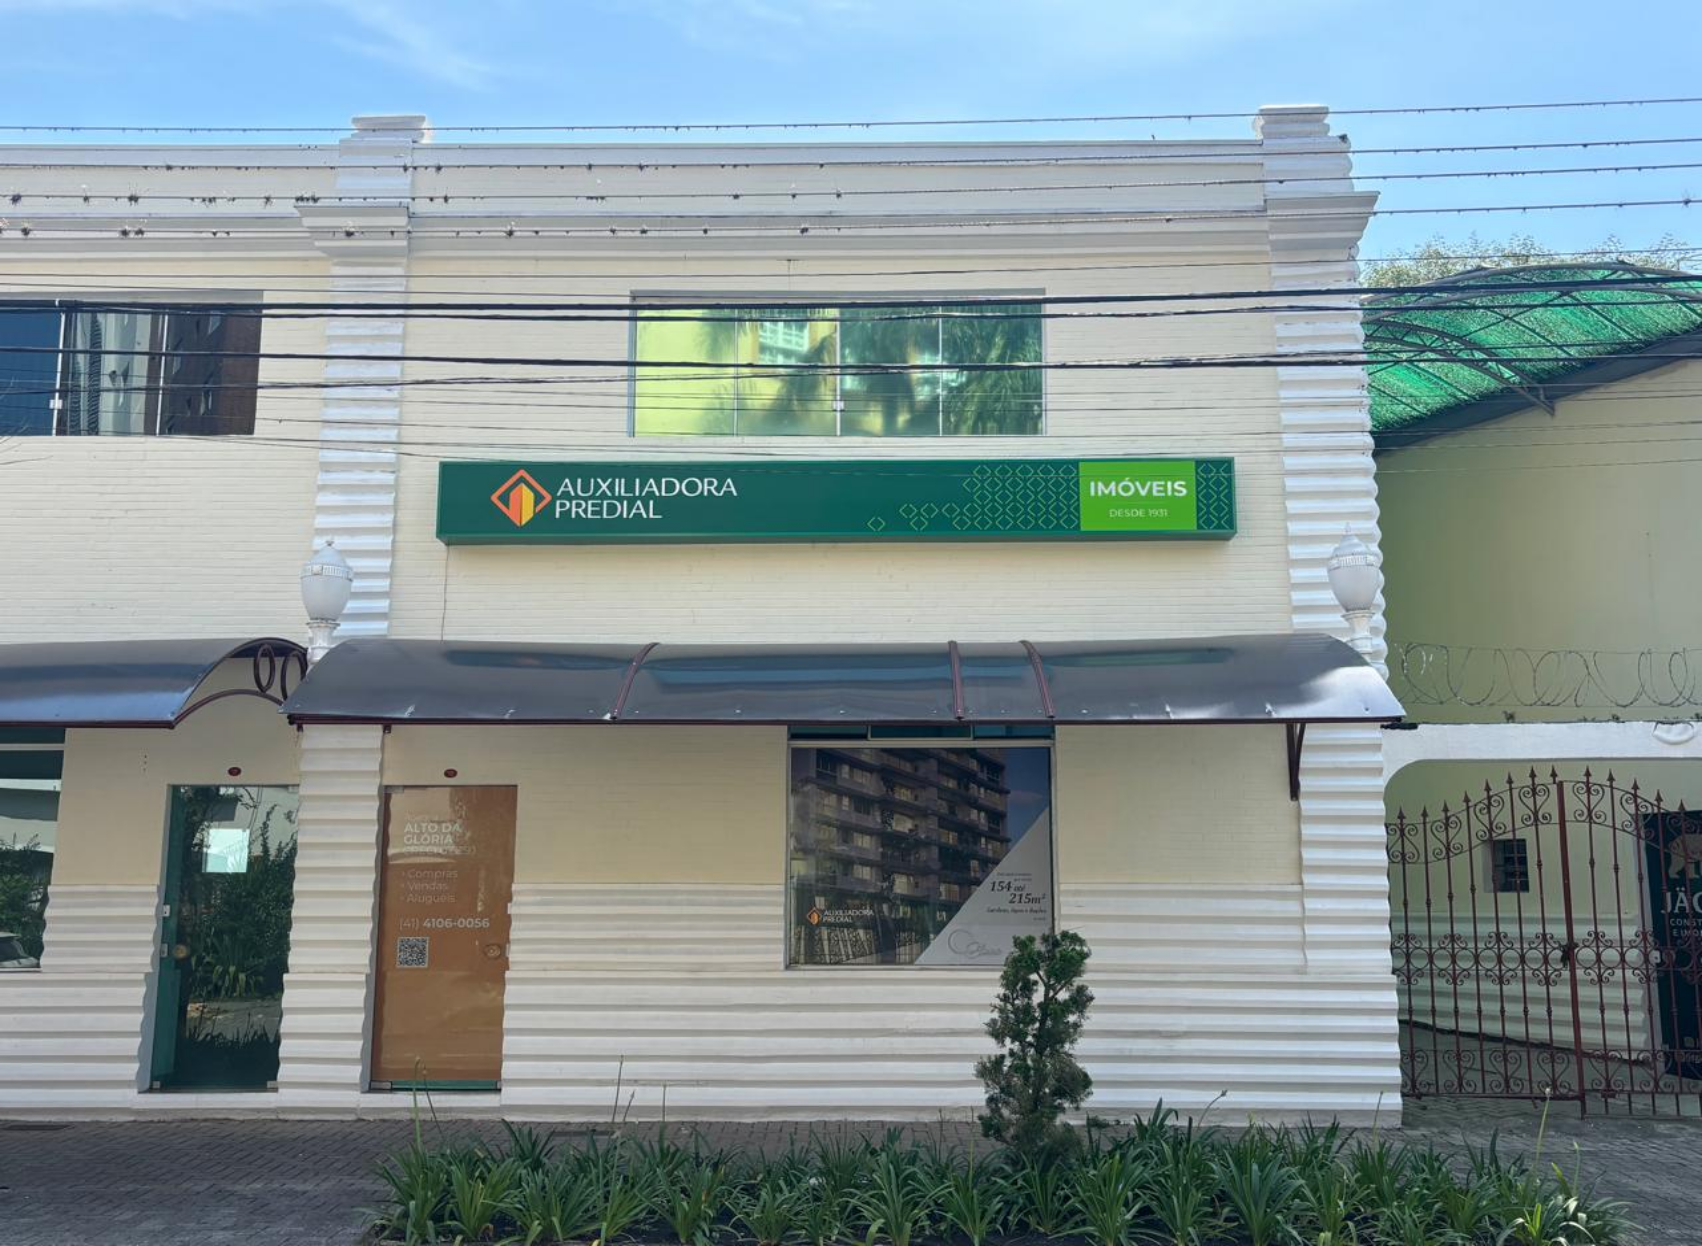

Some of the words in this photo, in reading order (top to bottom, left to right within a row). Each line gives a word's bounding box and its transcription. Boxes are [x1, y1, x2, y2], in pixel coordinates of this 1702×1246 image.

[556, 477, 738, 497] AUXILIADORA
[1089, 477, 1188, 497] IMÓVEIS
[555, 500, 662, 519] PREDIAL
[1109, 508, 1146, 518] DESDE
[1148, 508, 1168, 518] 1931
[403, 822, 438, 833] ALTO
[442, 822, 462, 833] DA
[407, 869, 459, 881] Compras
[407, 881, 448, 891] Vendas
[990, 881, 1012, 892] 154
[422, 918, 490, 929] 4106-0056
[822, 915, 852, 923] PREDIAL
